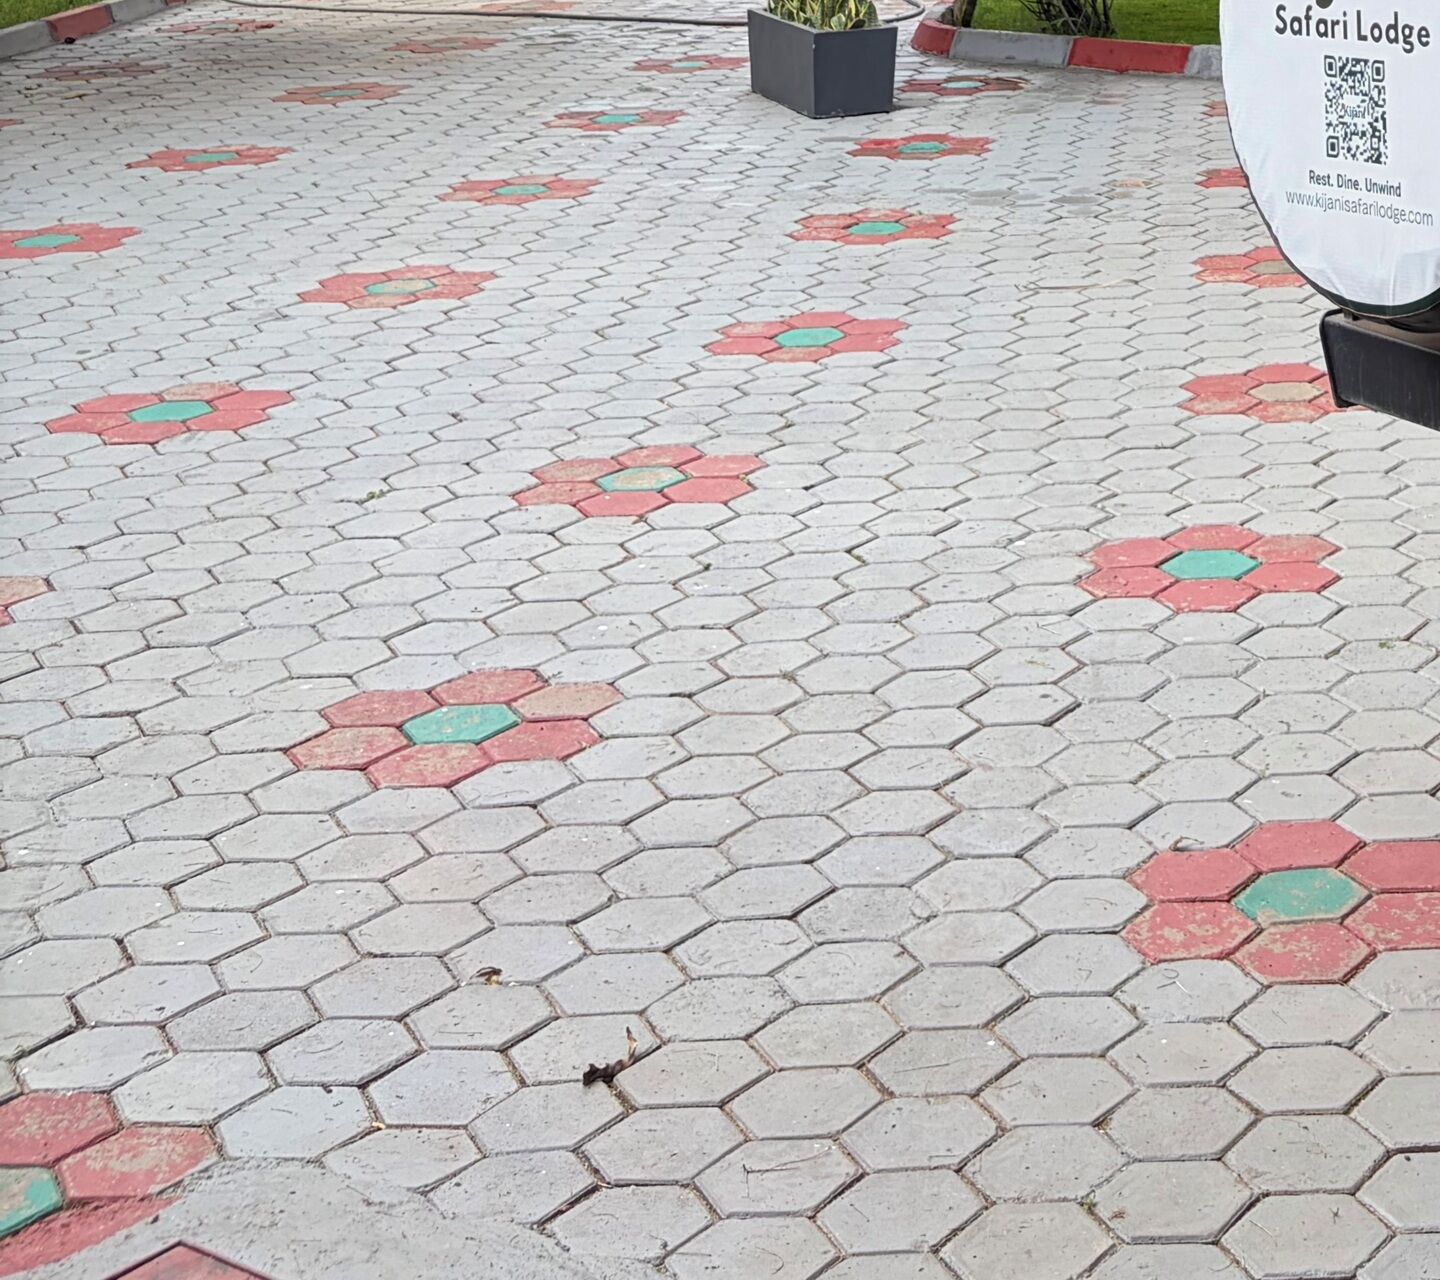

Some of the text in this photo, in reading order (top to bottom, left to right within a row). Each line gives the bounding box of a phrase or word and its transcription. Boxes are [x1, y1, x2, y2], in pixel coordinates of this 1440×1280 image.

[1274, 3, 1432, 54] Safari Lodge
[1308, 169, 1402, 198] Rest. Dine. Unwind
[1285, 190, 1434, 227] www.kijanisafarilodge.com
